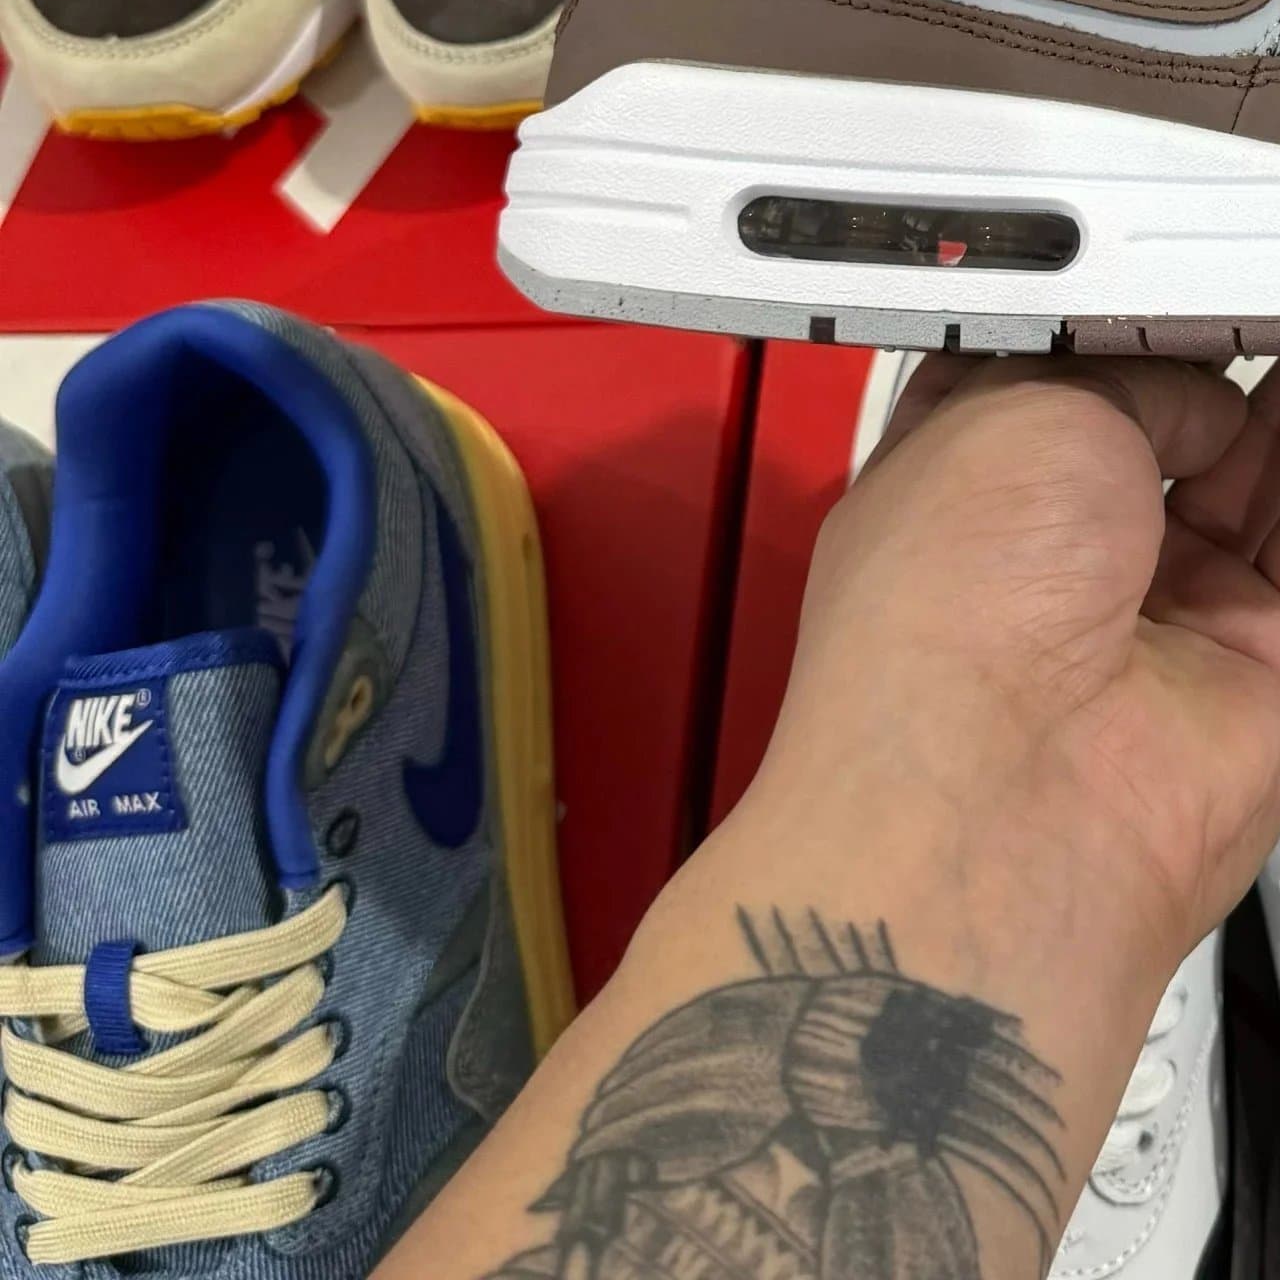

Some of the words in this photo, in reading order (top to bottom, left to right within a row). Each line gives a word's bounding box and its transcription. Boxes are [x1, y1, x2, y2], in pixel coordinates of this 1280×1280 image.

[66, 693, 137, 748] NIKE
[69, 798, 101, 819] AIR
[114, 791, 162, 815] MAX
